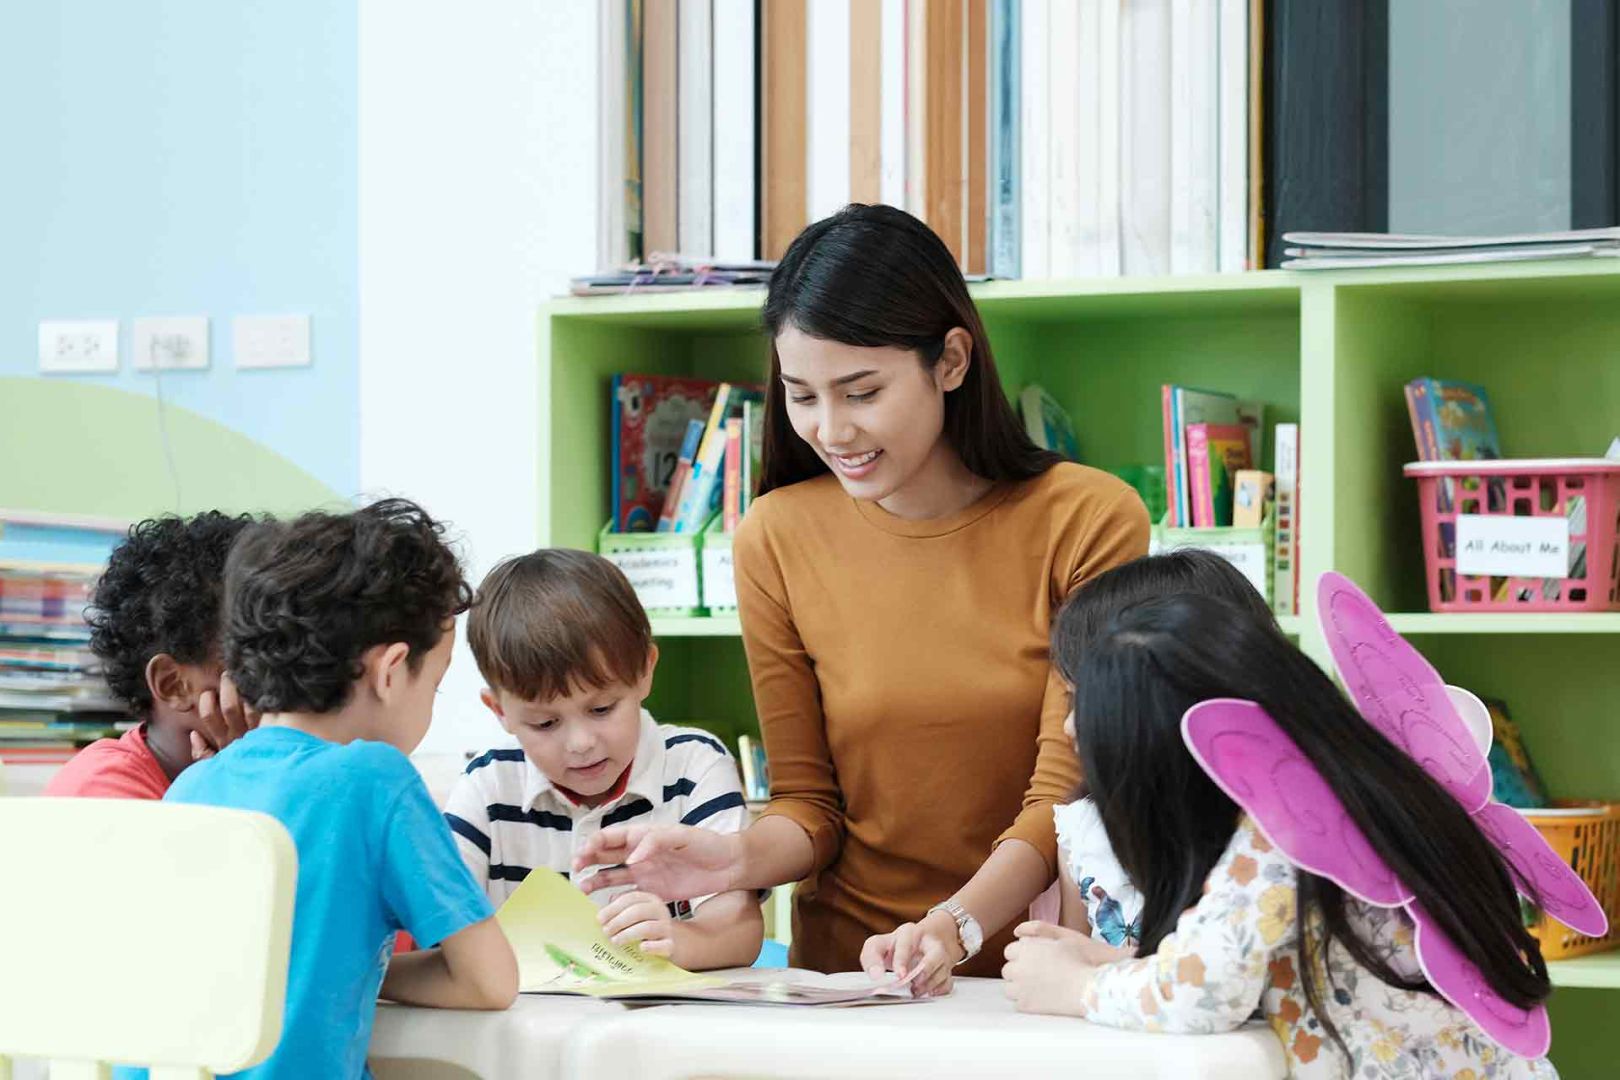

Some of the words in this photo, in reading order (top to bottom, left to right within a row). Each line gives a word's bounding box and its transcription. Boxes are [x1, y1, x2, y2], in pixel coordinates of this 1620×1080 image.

[1464, 540, 1484, 552] All
[1491, 540, 1531, 554] About
[1540, 542, 1560, 553] Me
